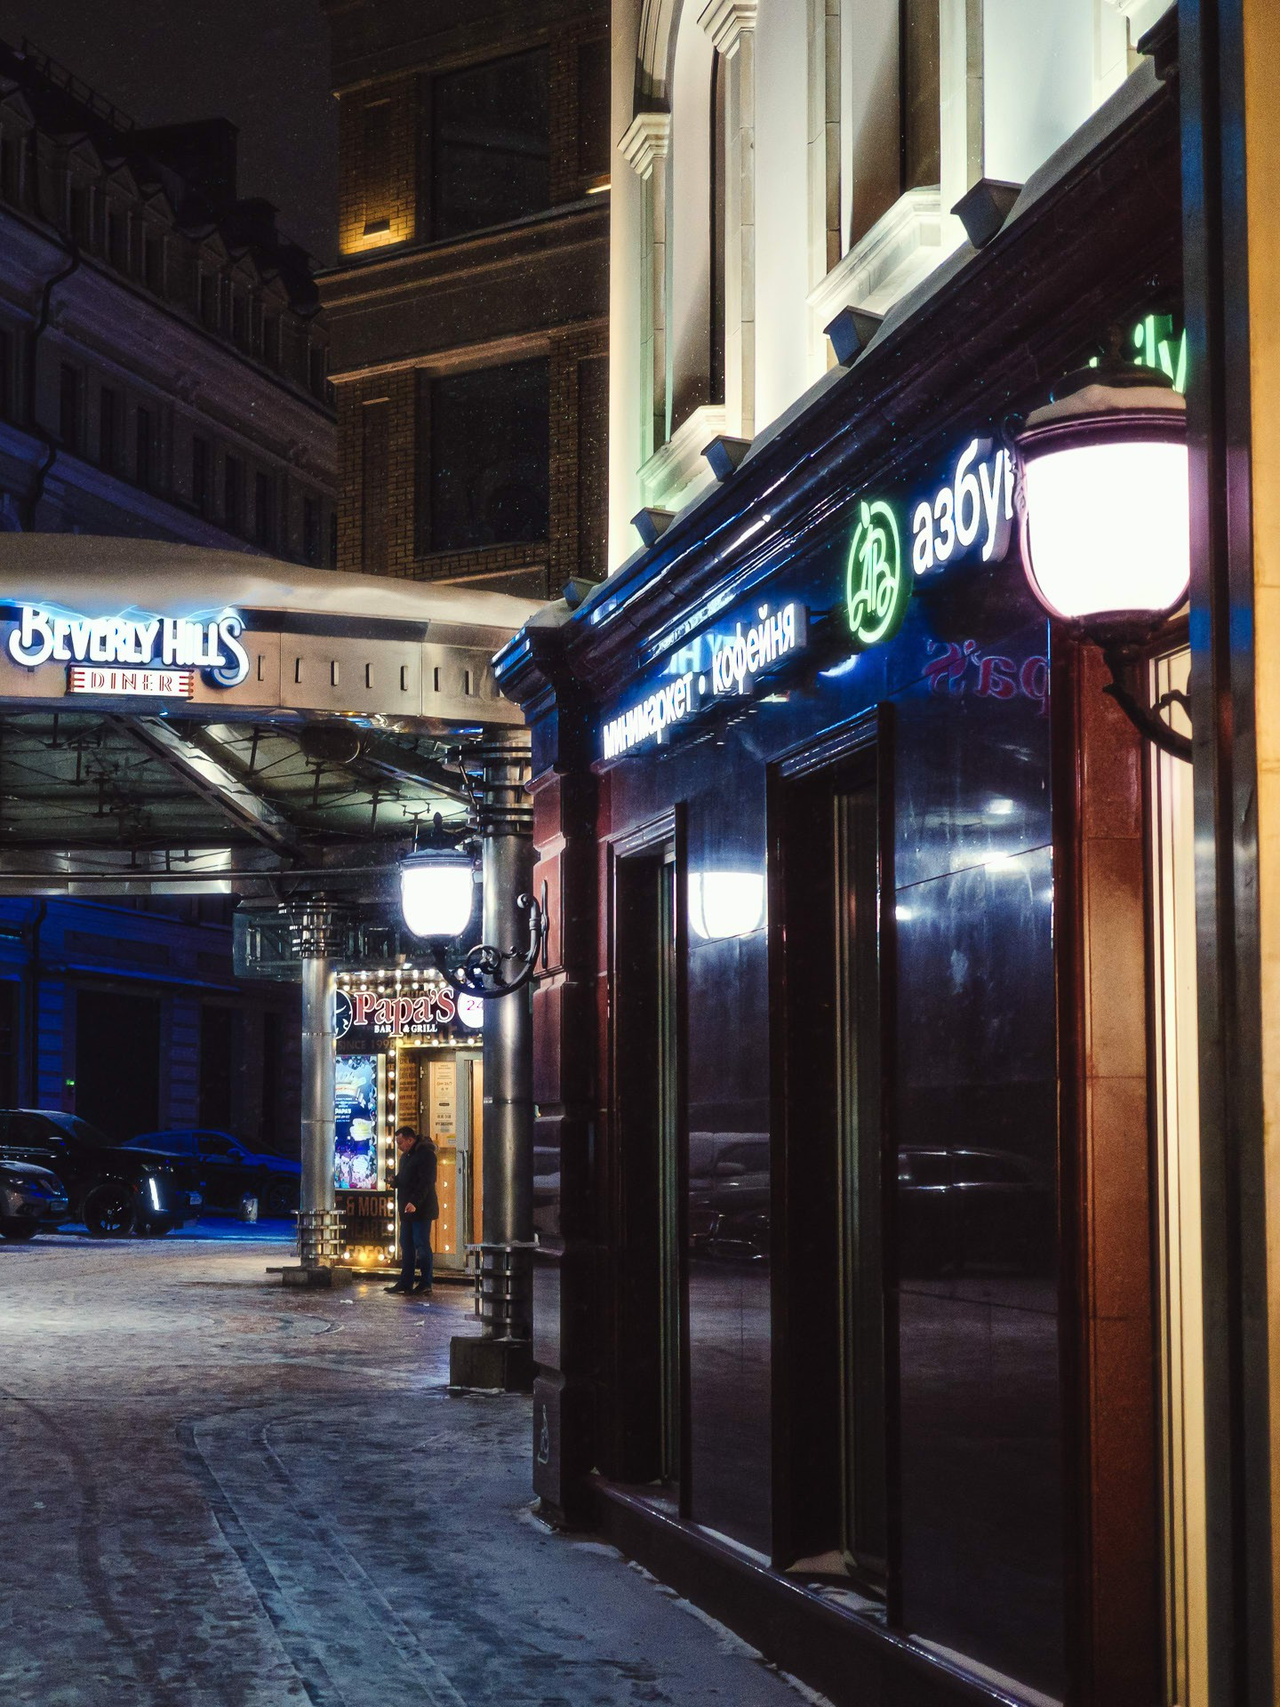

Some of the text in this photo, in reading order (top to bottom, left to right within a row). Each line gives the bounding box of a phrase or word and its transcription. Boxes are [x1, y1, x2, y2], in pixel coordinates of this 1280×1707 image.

[90, 671, 174, 692] DINER
[603, 671, 694, 761] минимаркет
[712, 603, 796, 695] кофейня
[374, 1025, 391, 1034] BAR
[411, 1024, 438, 1033] GRILL
